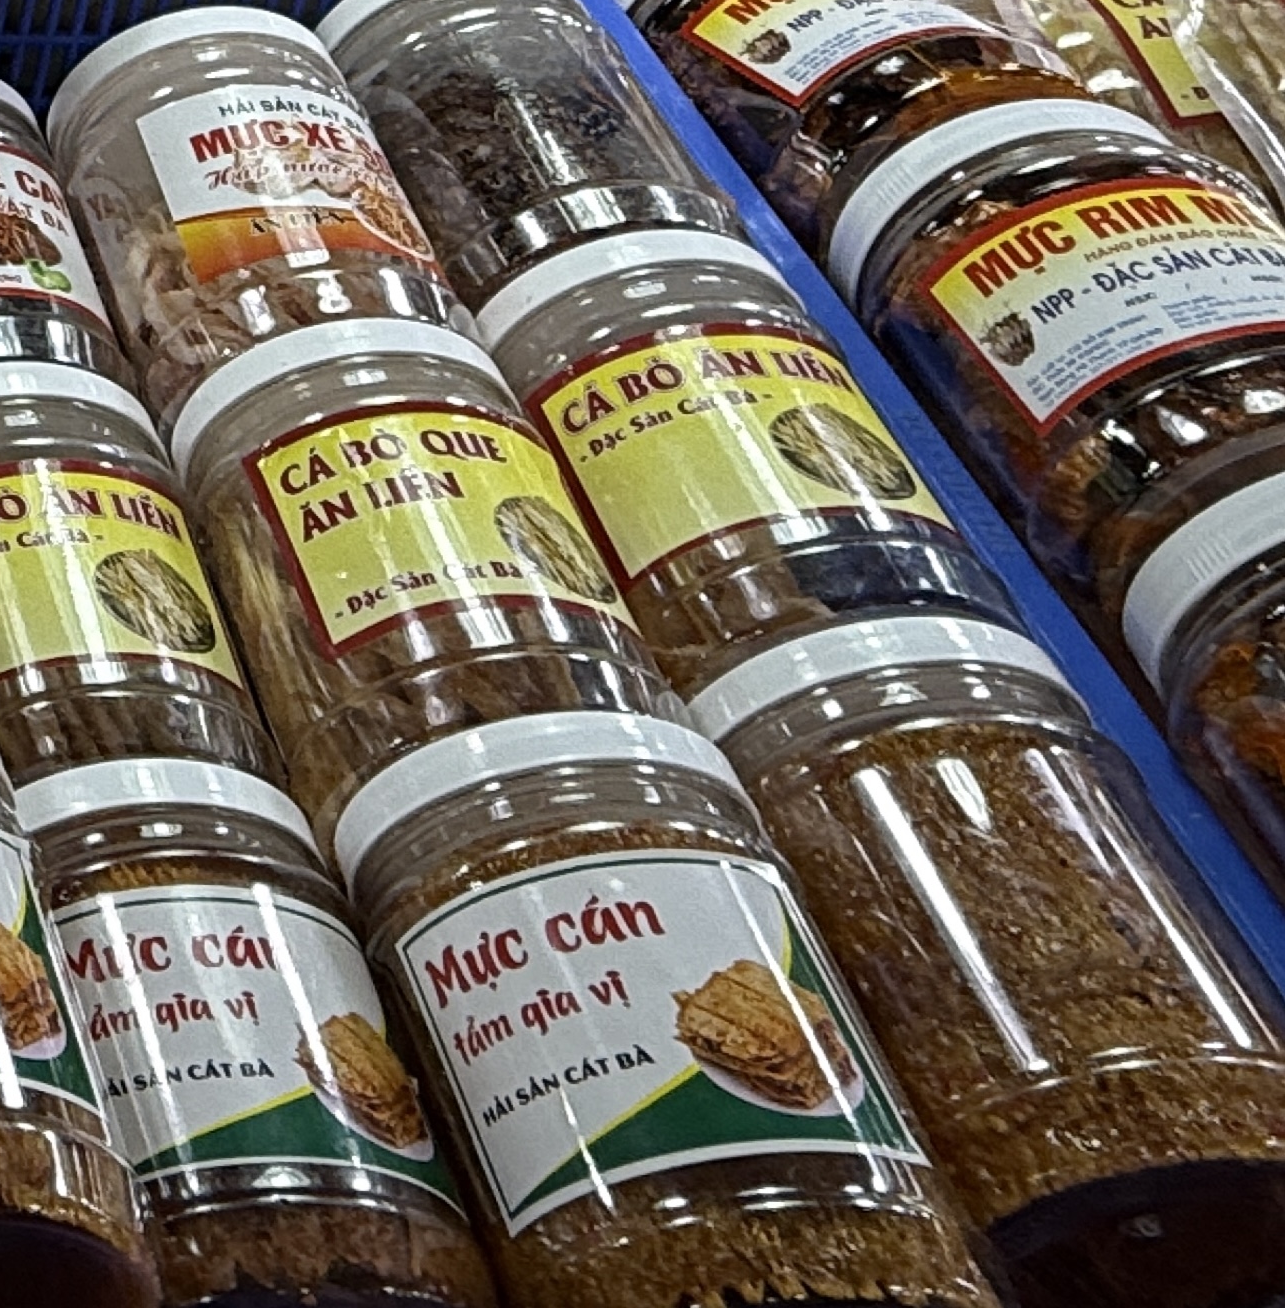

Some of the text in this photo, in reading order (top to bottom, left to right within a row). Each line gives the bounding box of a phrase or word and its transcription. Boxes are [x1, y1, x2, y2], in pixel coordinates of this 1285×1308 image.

[787, 8, 824, 33] NPP
[189, 114, 351, 164] MỰC XÉ
[963, 221, 1077, 299] MỰC
[1075, 194, 1193, 240] RIM
[1084, 228, 1214, 263] HÀNG ĐẢM BẢO
[1031, 241, 1263, 324] NPP ĐẶC SẢN CÁT
[560, 347, 854, 435] CÁ BÒ ĂN LIỀN
[588, 428, 627, 459] Đặc
[629, 409, 673, 434] Sản
[279, 427, 508, 496] CÁ BÒ QUE
[110, 492, 184, 544] LIỀN
[302, 463, 466, 543] ĂN LIỀN
[345, 590, 388, 616] Đặc
[391, 572, 437, 595] Sản
[425, 895, 665, 1009] Mực cán
[520, 989, 582, 1036] gia
[187, 1058, 275, 1081] CÁT BÀ
[482, 1044, 656, 1127] HẢI SẢN CÁT BÀ
